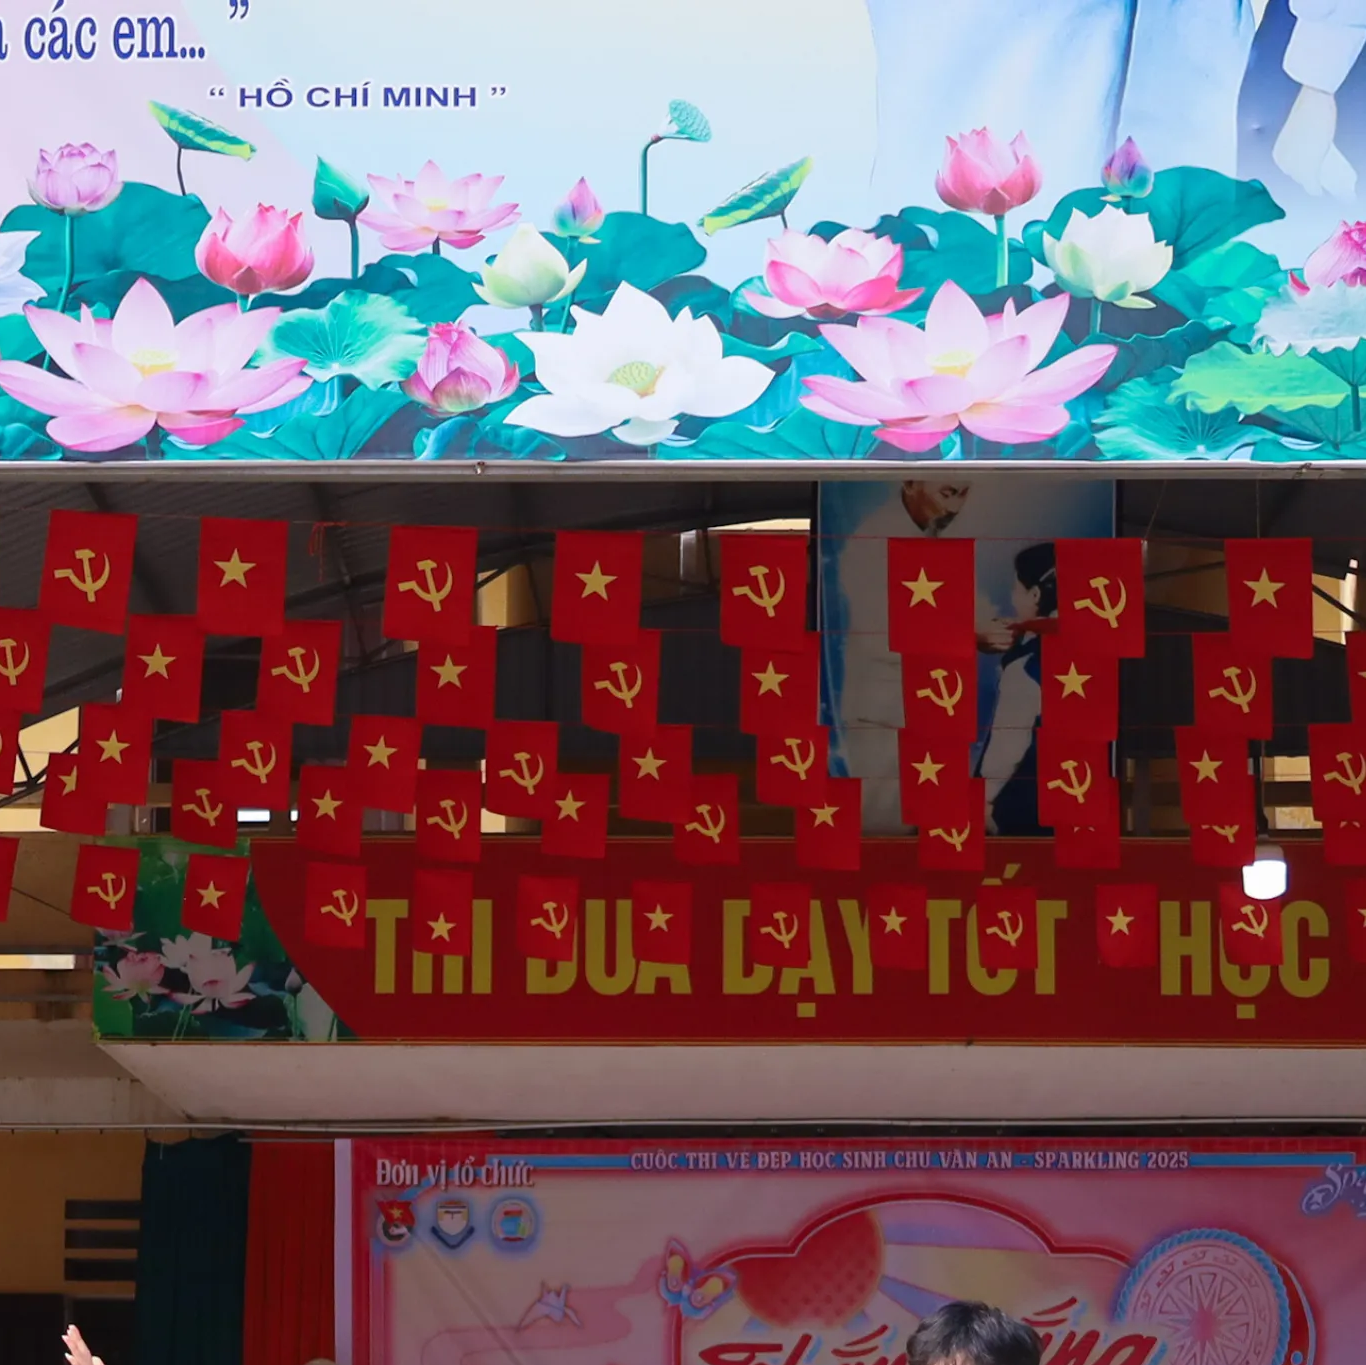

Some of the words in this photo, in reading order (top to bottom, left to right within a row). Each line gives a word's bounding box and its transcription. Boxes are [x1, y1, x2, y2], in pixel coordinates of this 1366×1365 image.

[24, 0, 97, 60] các
[238, 77, 294, 109] HỒ
[305, 80, 372, 109] CHÍ
[382, 85, 479, 108] MINH
[376, 1158, 419, 1186] Đơn
[427, 1159, 448, 1191] vị
[454, 1156, 476, 1186] tổ
[482, 1157, 535, 1187] chức
[685, 1151, 717, 1170] THI
[842, 1150, 887, 1169] SINH
[894, 1150, 931, 1169] CHU
[939, 1148, 977, 1169] VĂN
[986, 1151, 1013, 1169] AN
[1034, 1151, 1140, 1169] SPARKLING
[1147, 1151, 1188, 1169] 2025
